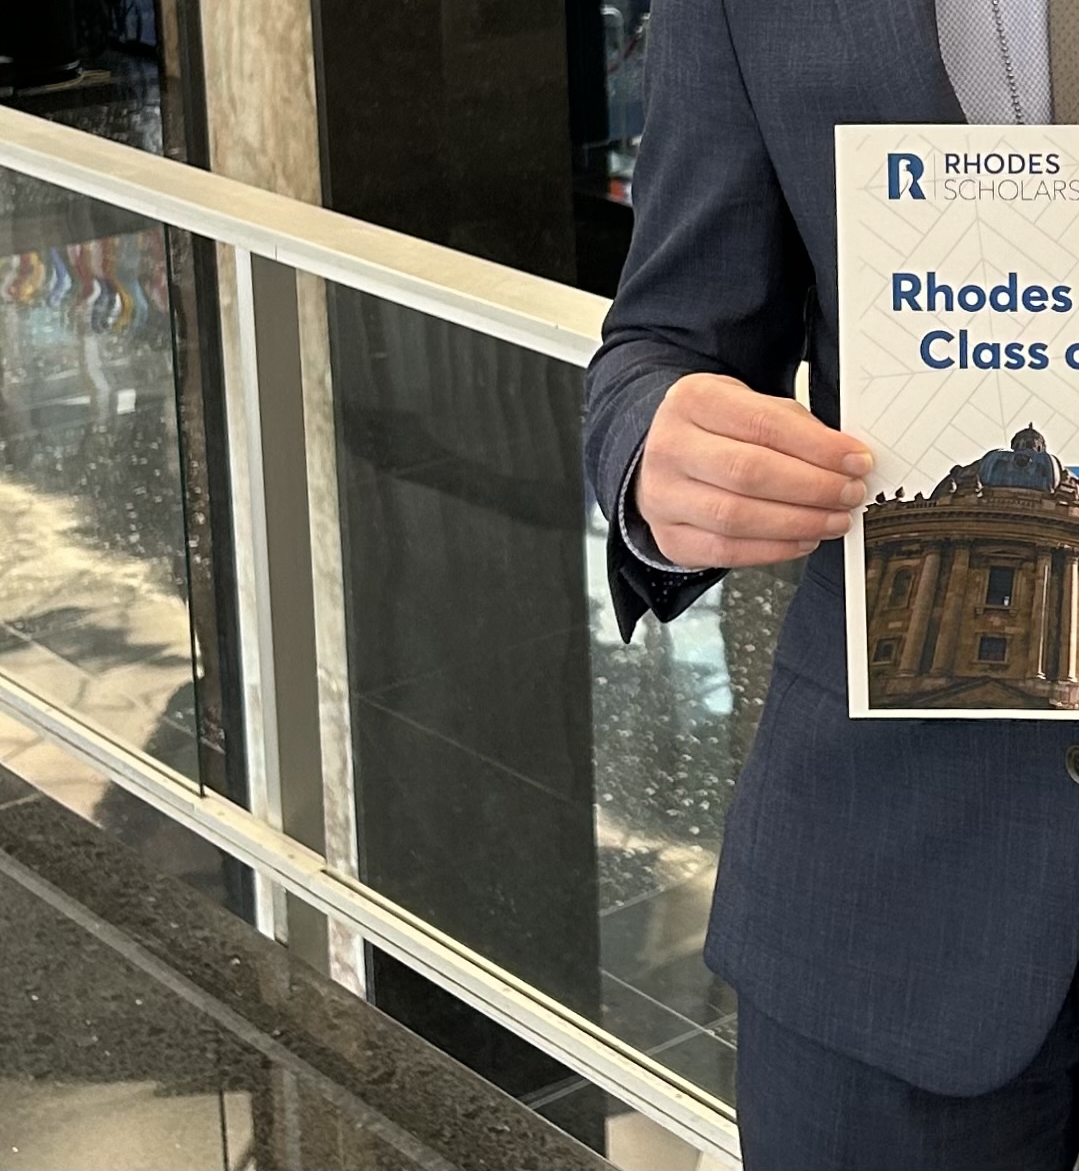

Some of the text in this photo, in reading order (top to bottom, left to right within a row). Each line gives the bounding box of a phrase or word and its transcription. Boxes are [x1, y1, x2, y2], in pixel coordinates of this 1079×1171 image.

[945, 153, 1060, 175] RHODES
[892, 271, 1073, 313] Rhodes
[919, 329, 1050, 371] Class
